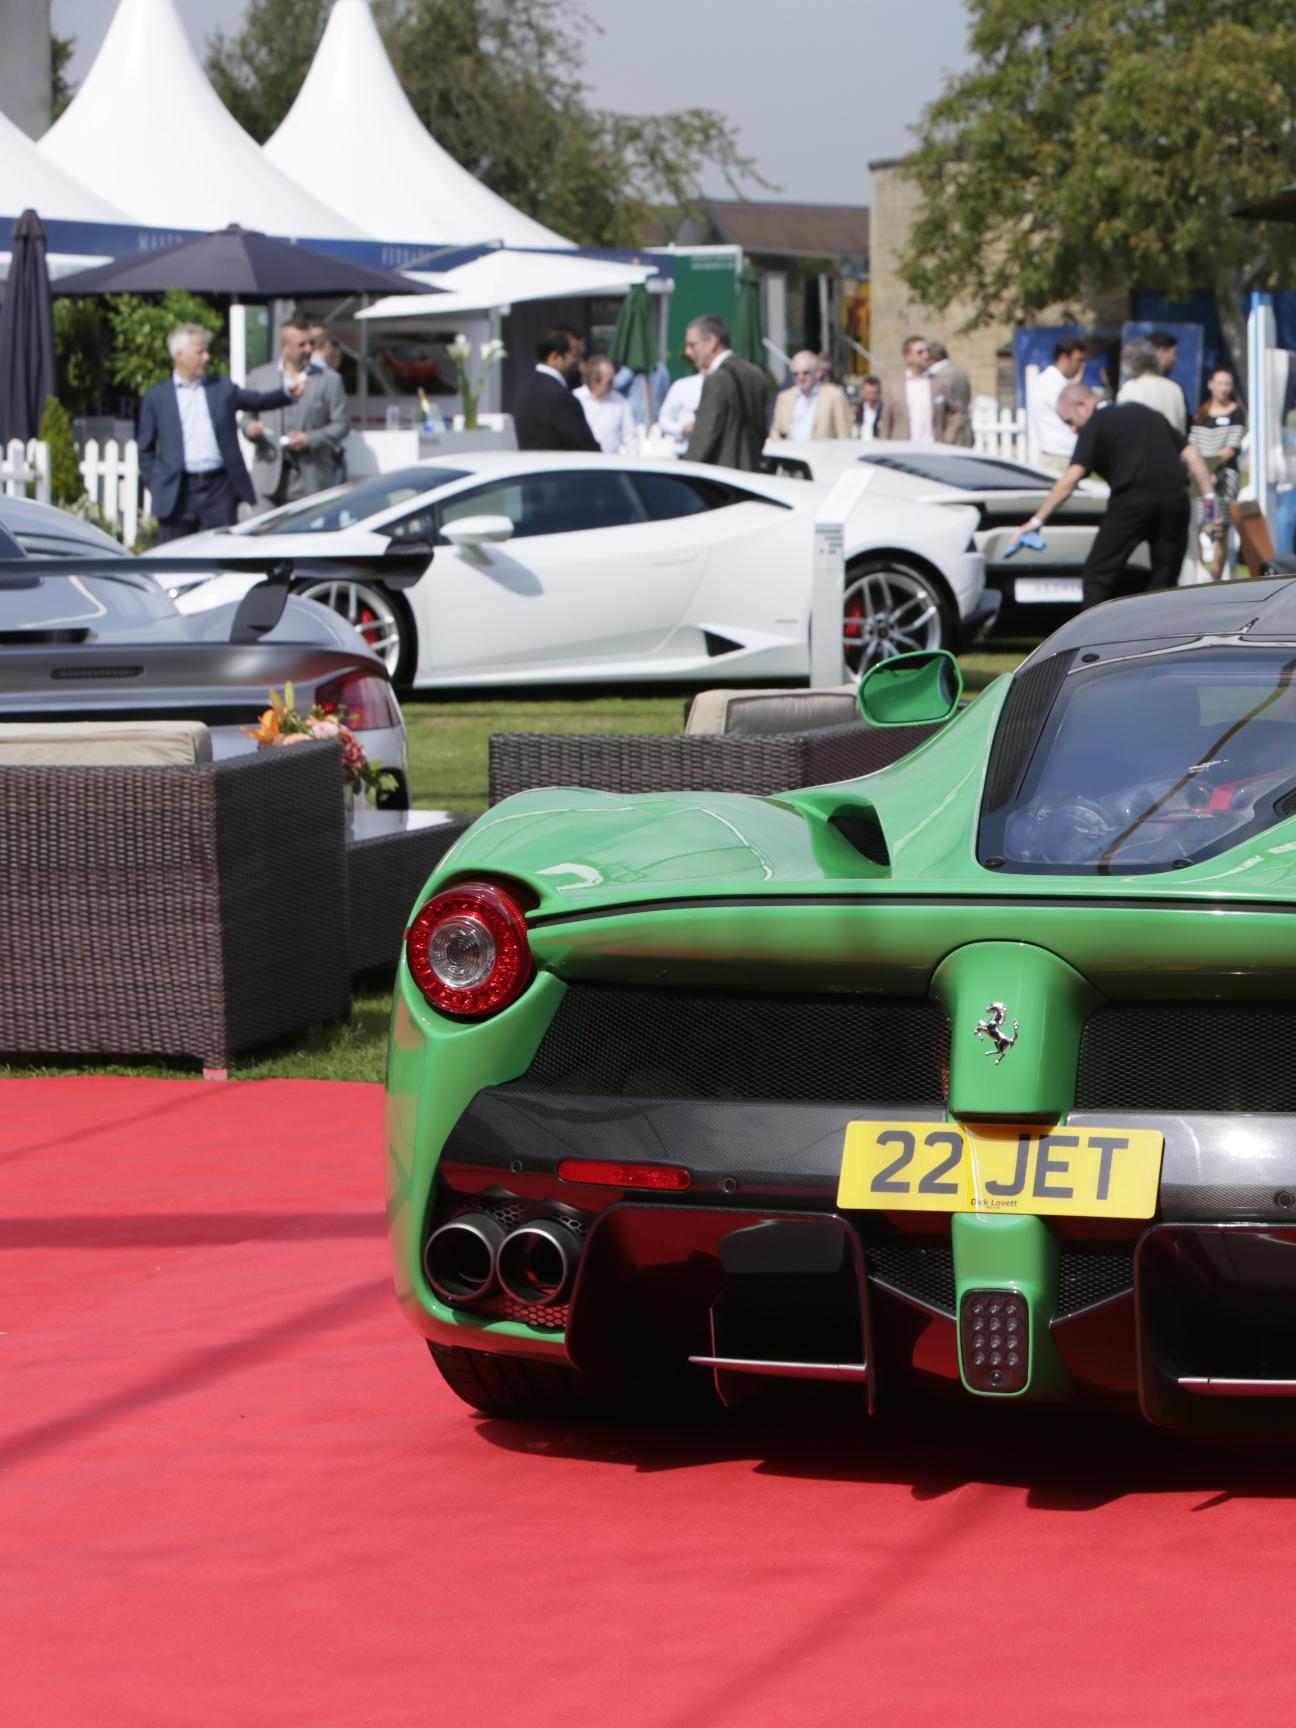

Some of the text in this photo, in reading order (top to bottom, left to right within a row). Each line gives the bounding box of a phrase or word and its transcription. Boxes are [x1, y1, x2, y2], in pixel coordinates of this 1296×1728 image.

[870, 1130, 1129, 1200] 22 JET
[991, 1199, 1018, 1207] Lovett
